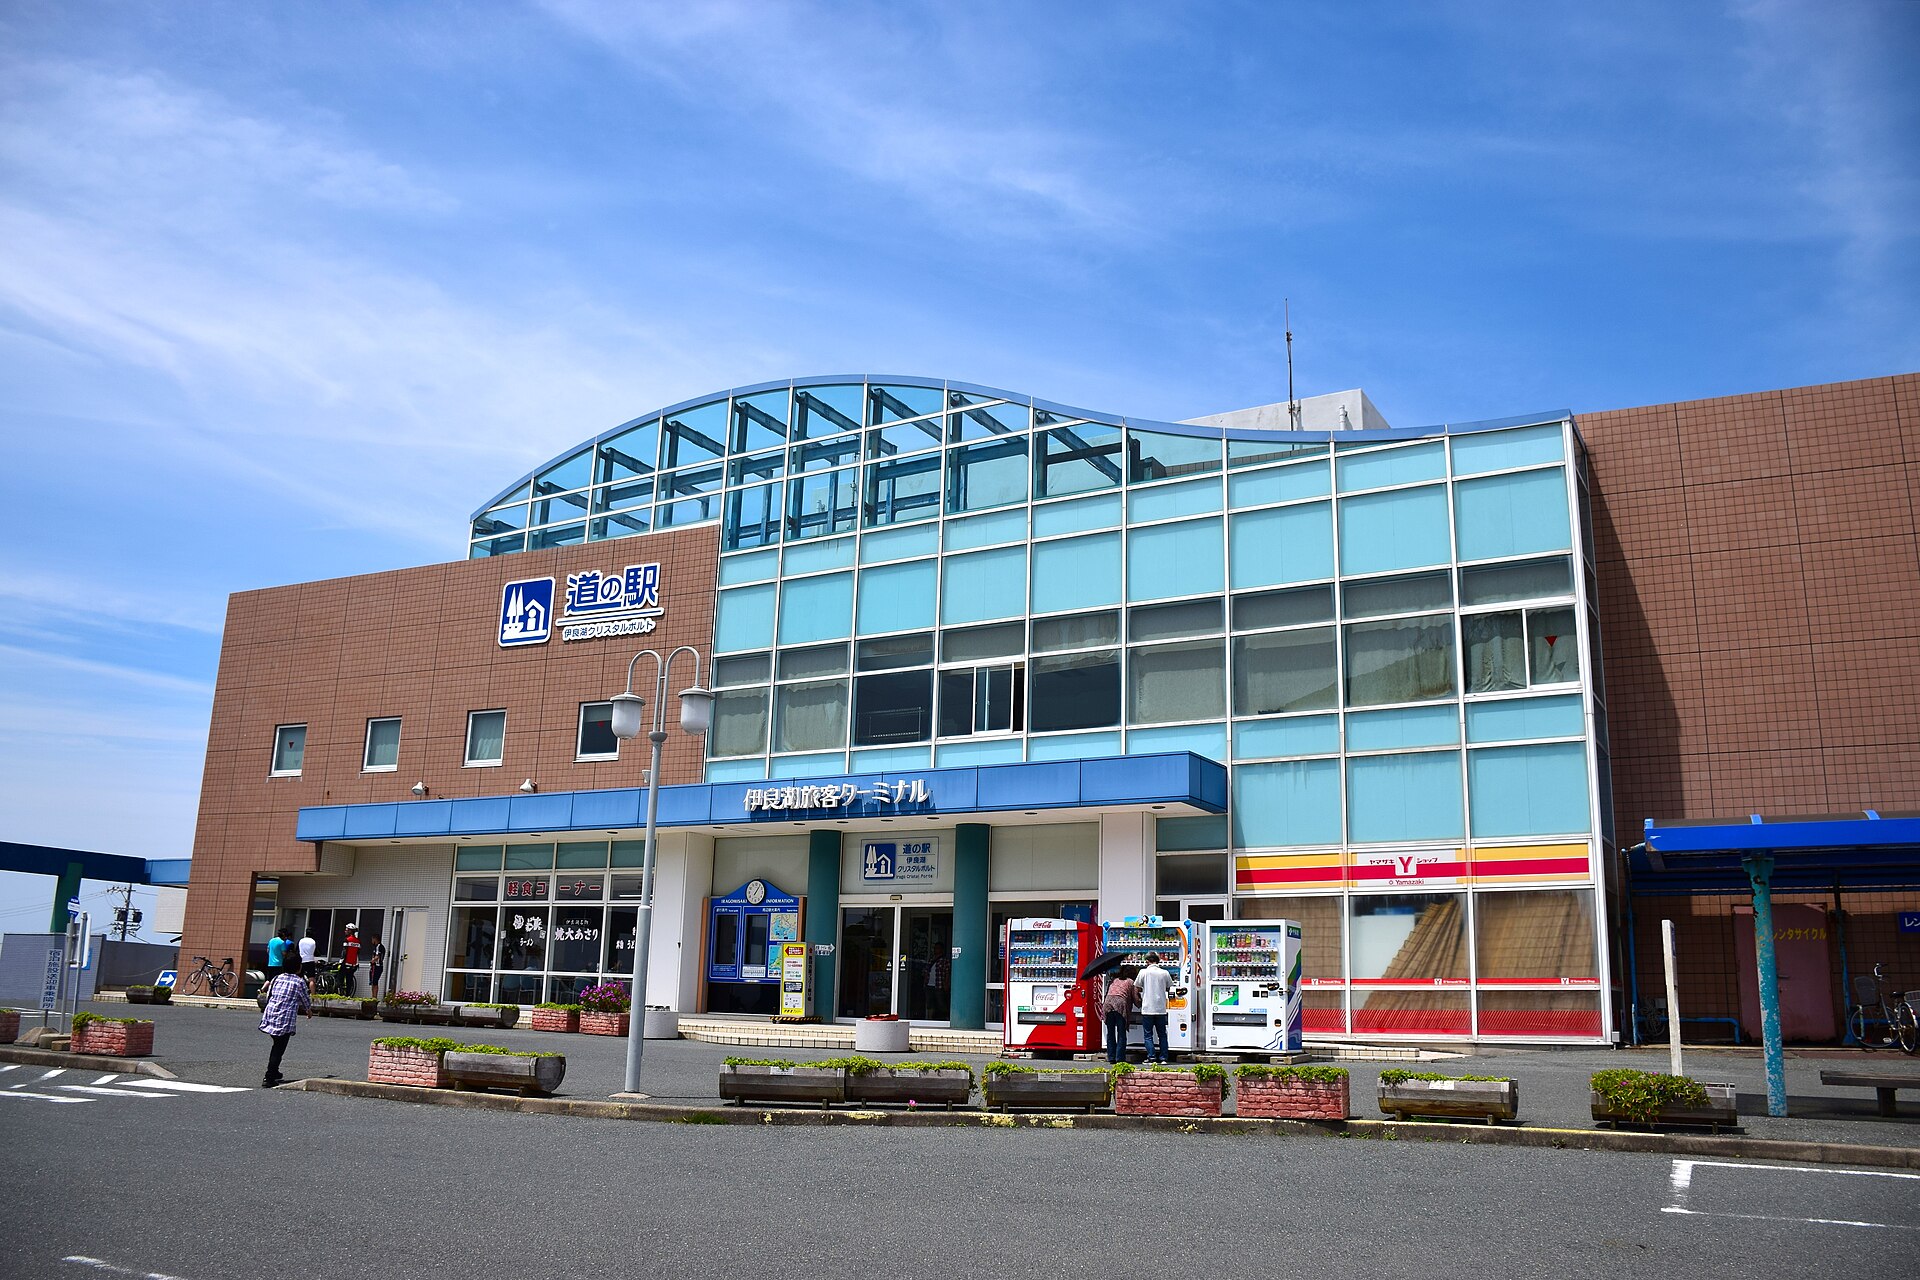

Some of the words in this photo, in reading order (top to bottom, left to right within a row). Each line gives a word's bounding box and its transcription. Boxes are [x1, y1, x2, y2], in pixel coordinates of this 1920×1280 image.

[565, 564, 659, 613] 道の駅
[743, 779, 929, 811] 伊良湖旅客ターミナル
[902, 843, 931, 854] 道の駅
[906, 856, 926, 864] 伊良湖
[1398, 856, 1413, 873] Y
[507, 880, 601, 897] 軽食コーナー
[555, 927, 599, 941] 焼大あさり
